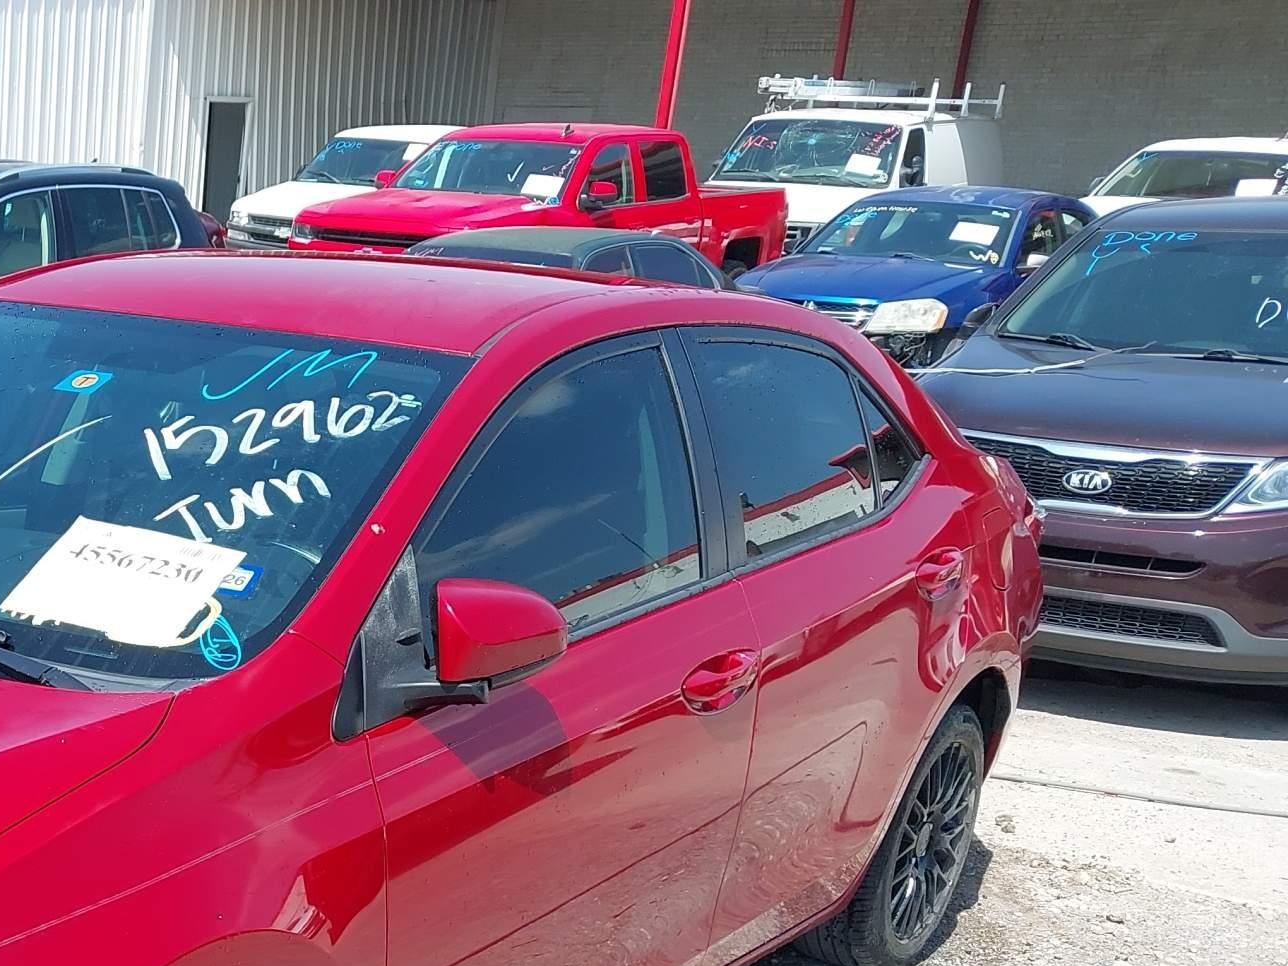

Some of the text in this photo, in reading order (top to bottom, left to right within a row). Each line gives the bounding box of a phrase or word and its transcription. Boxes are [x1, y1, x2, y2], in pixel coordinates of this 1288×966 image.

[202, 349, 378, 400] JM
[1069, 471, 1103, 490] KIA
[69, 543, 205, 583] 45567230
